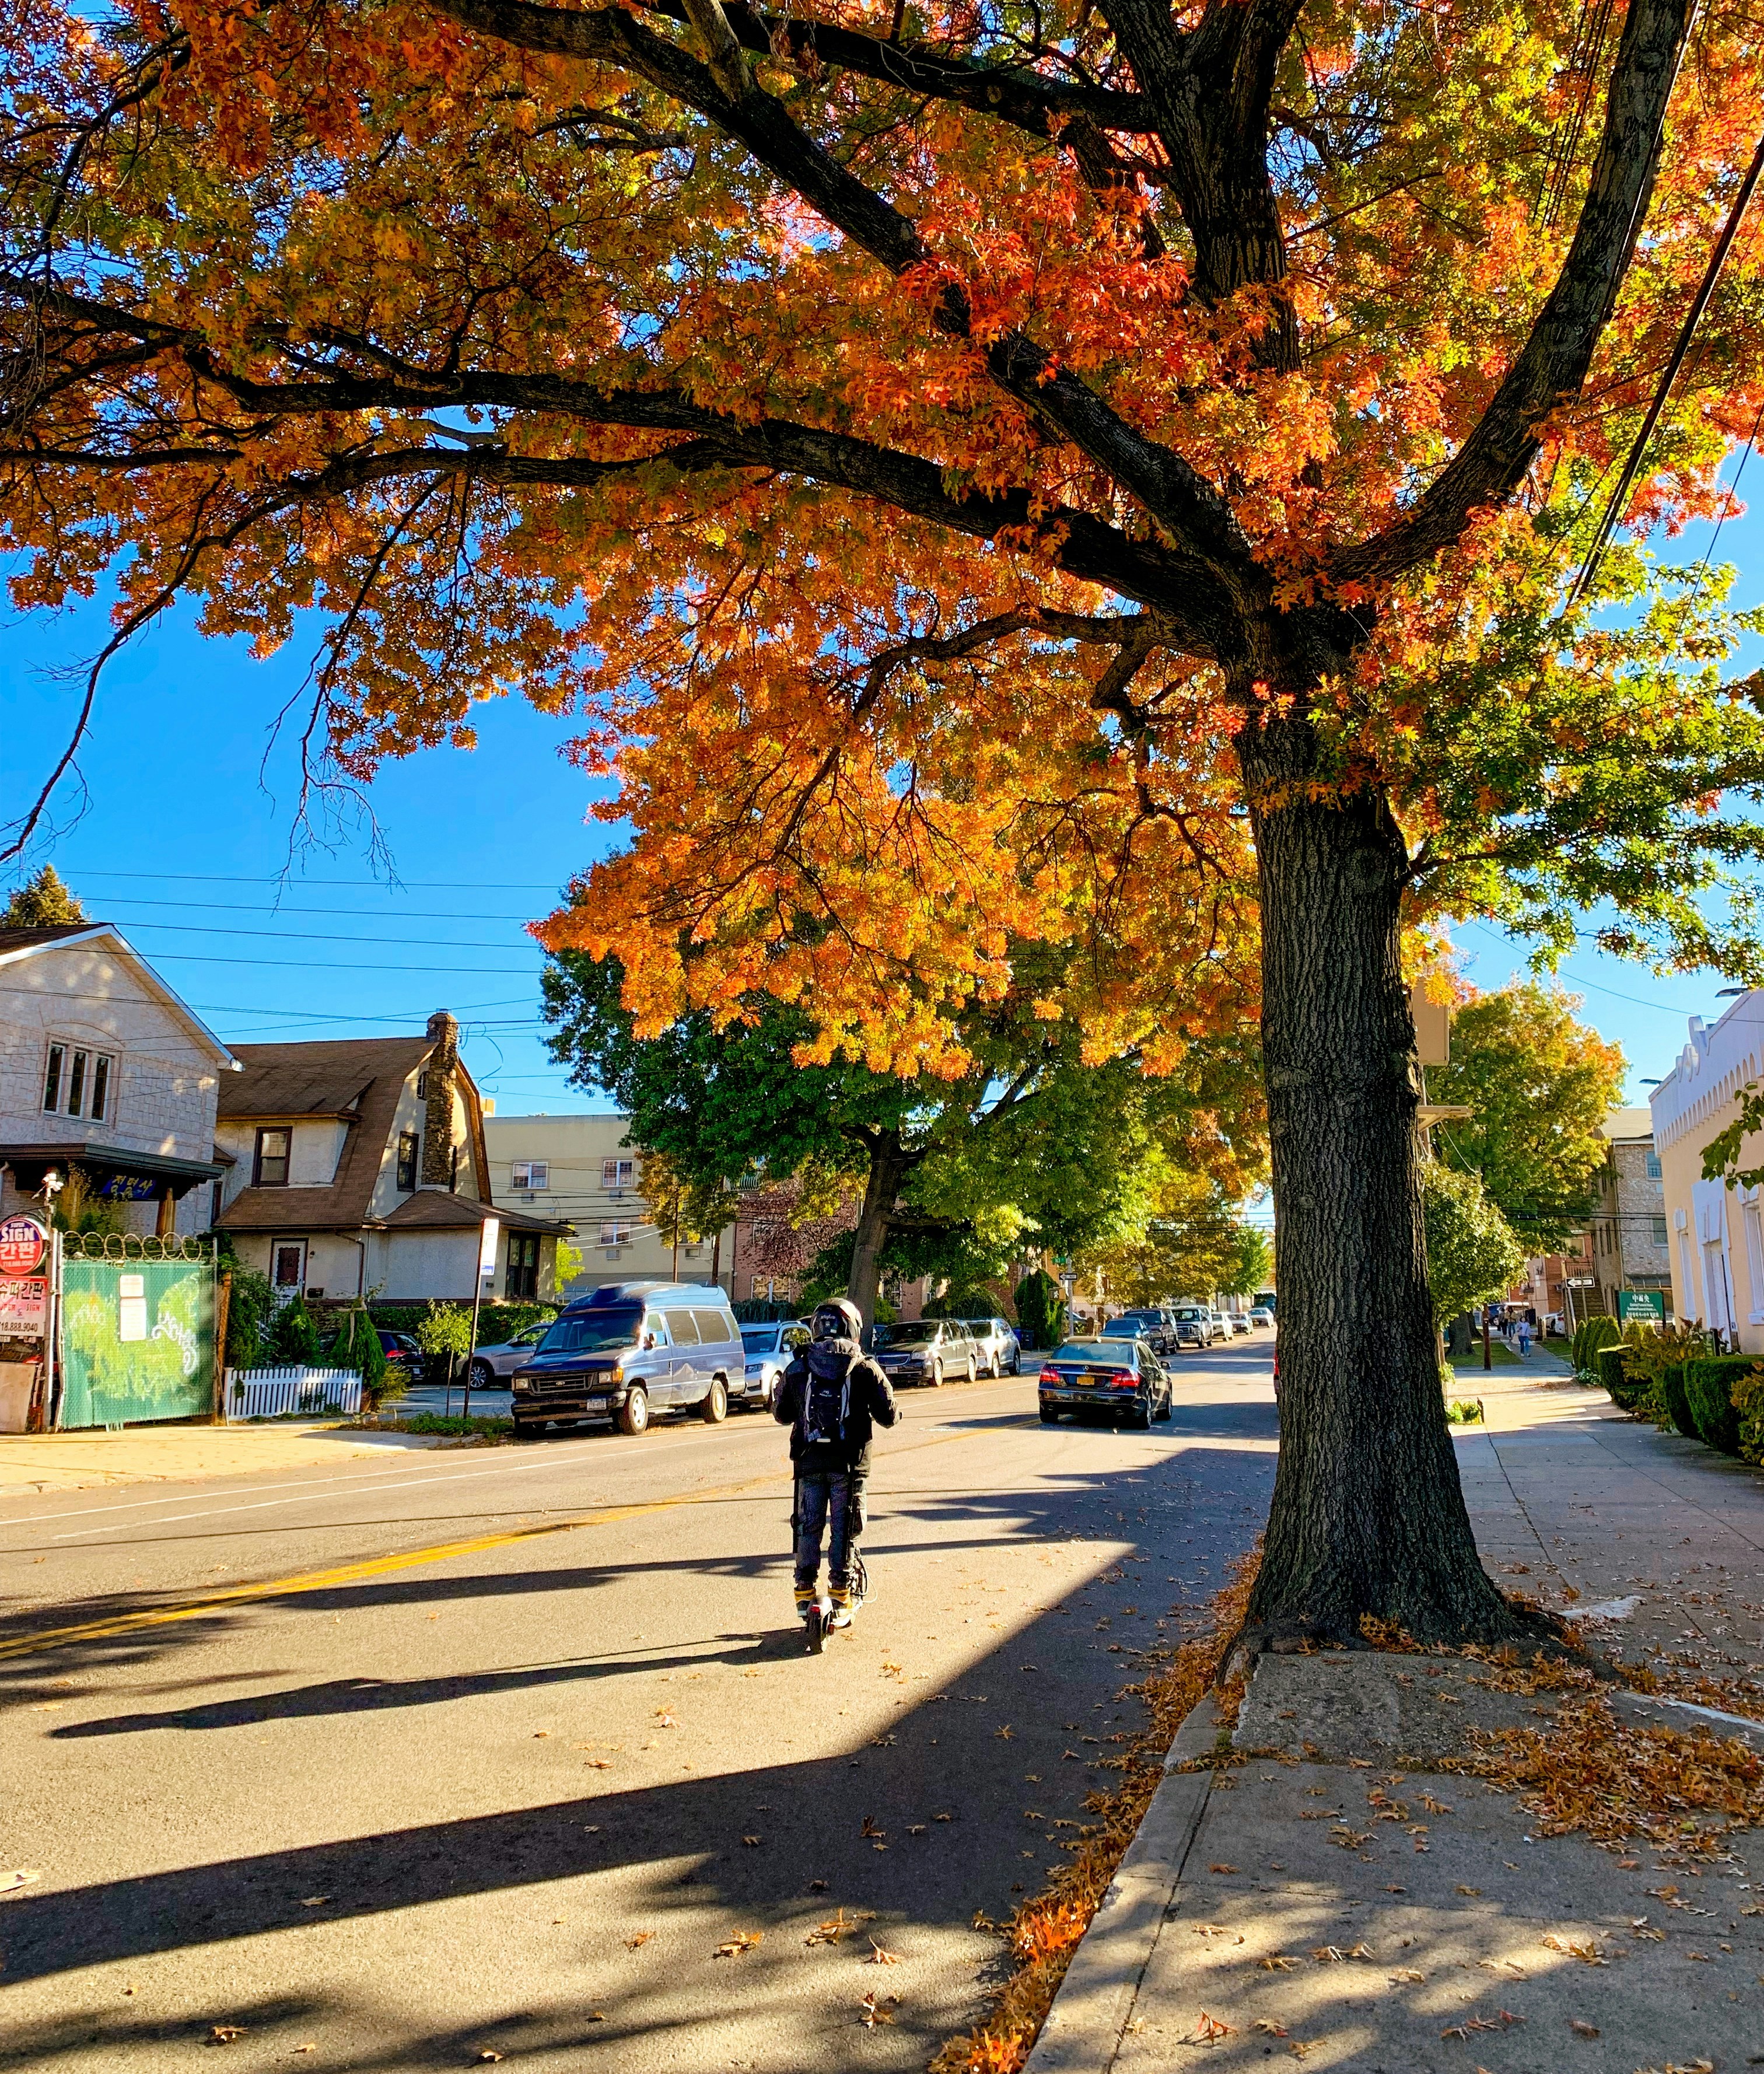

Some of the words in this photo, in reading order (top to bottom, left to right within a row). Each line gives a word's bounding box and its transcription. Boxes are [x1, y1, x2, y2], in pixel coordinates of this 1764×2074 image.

[1, 1226, 34, 1242] SIGN
[0, 1243, 36, 1260] 간판
[0, 1322, 38, 1332] 18.888.9040
